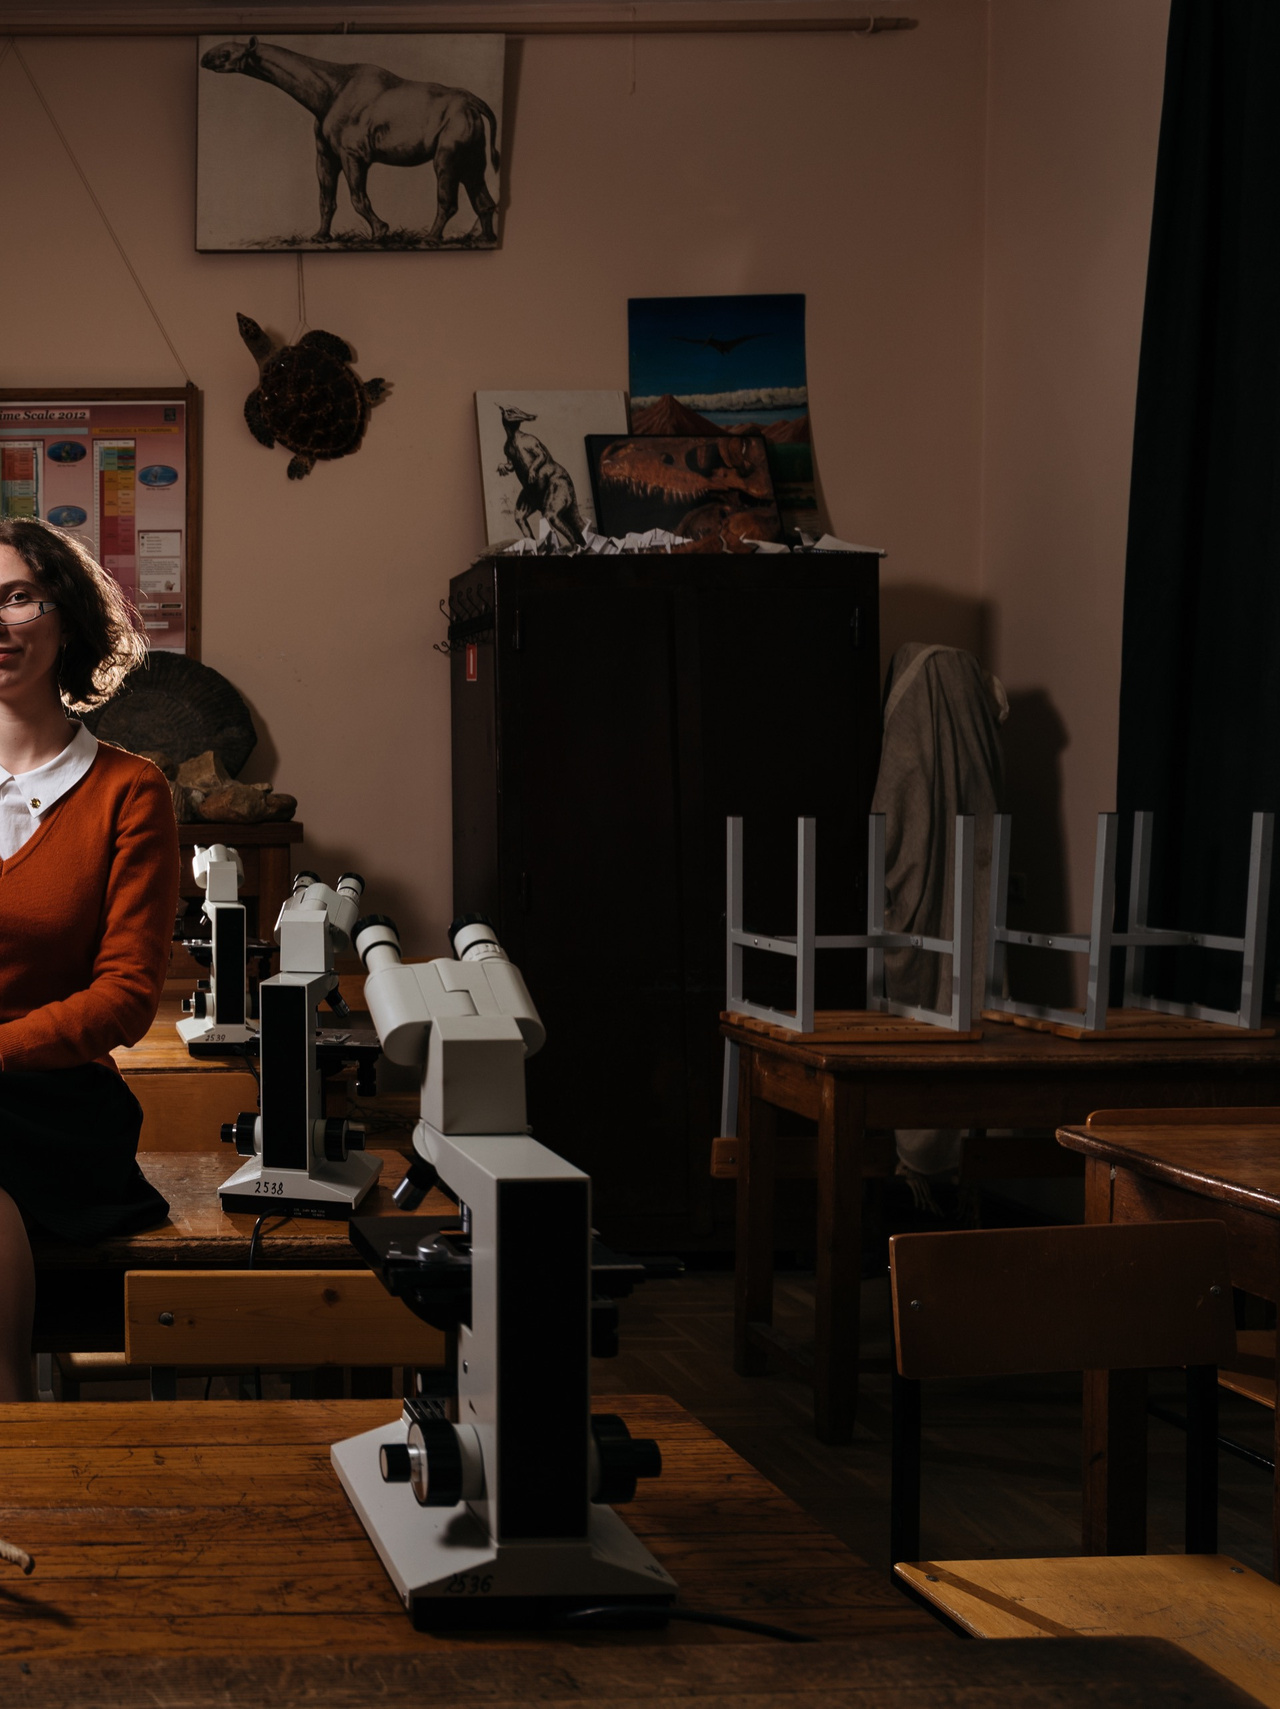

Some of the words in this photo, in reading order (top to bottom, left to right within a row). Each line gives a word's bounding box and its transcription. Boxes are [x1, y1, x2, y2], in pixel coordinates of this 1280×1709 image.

[24, 410, 55, 420] Scale
[58, 411, 86, 420] 2012
[205, 1034, 226, 1042] 2539
[254, 1181, 284, 1196] 2538
[444, 1573, 494, 1594] 2536
